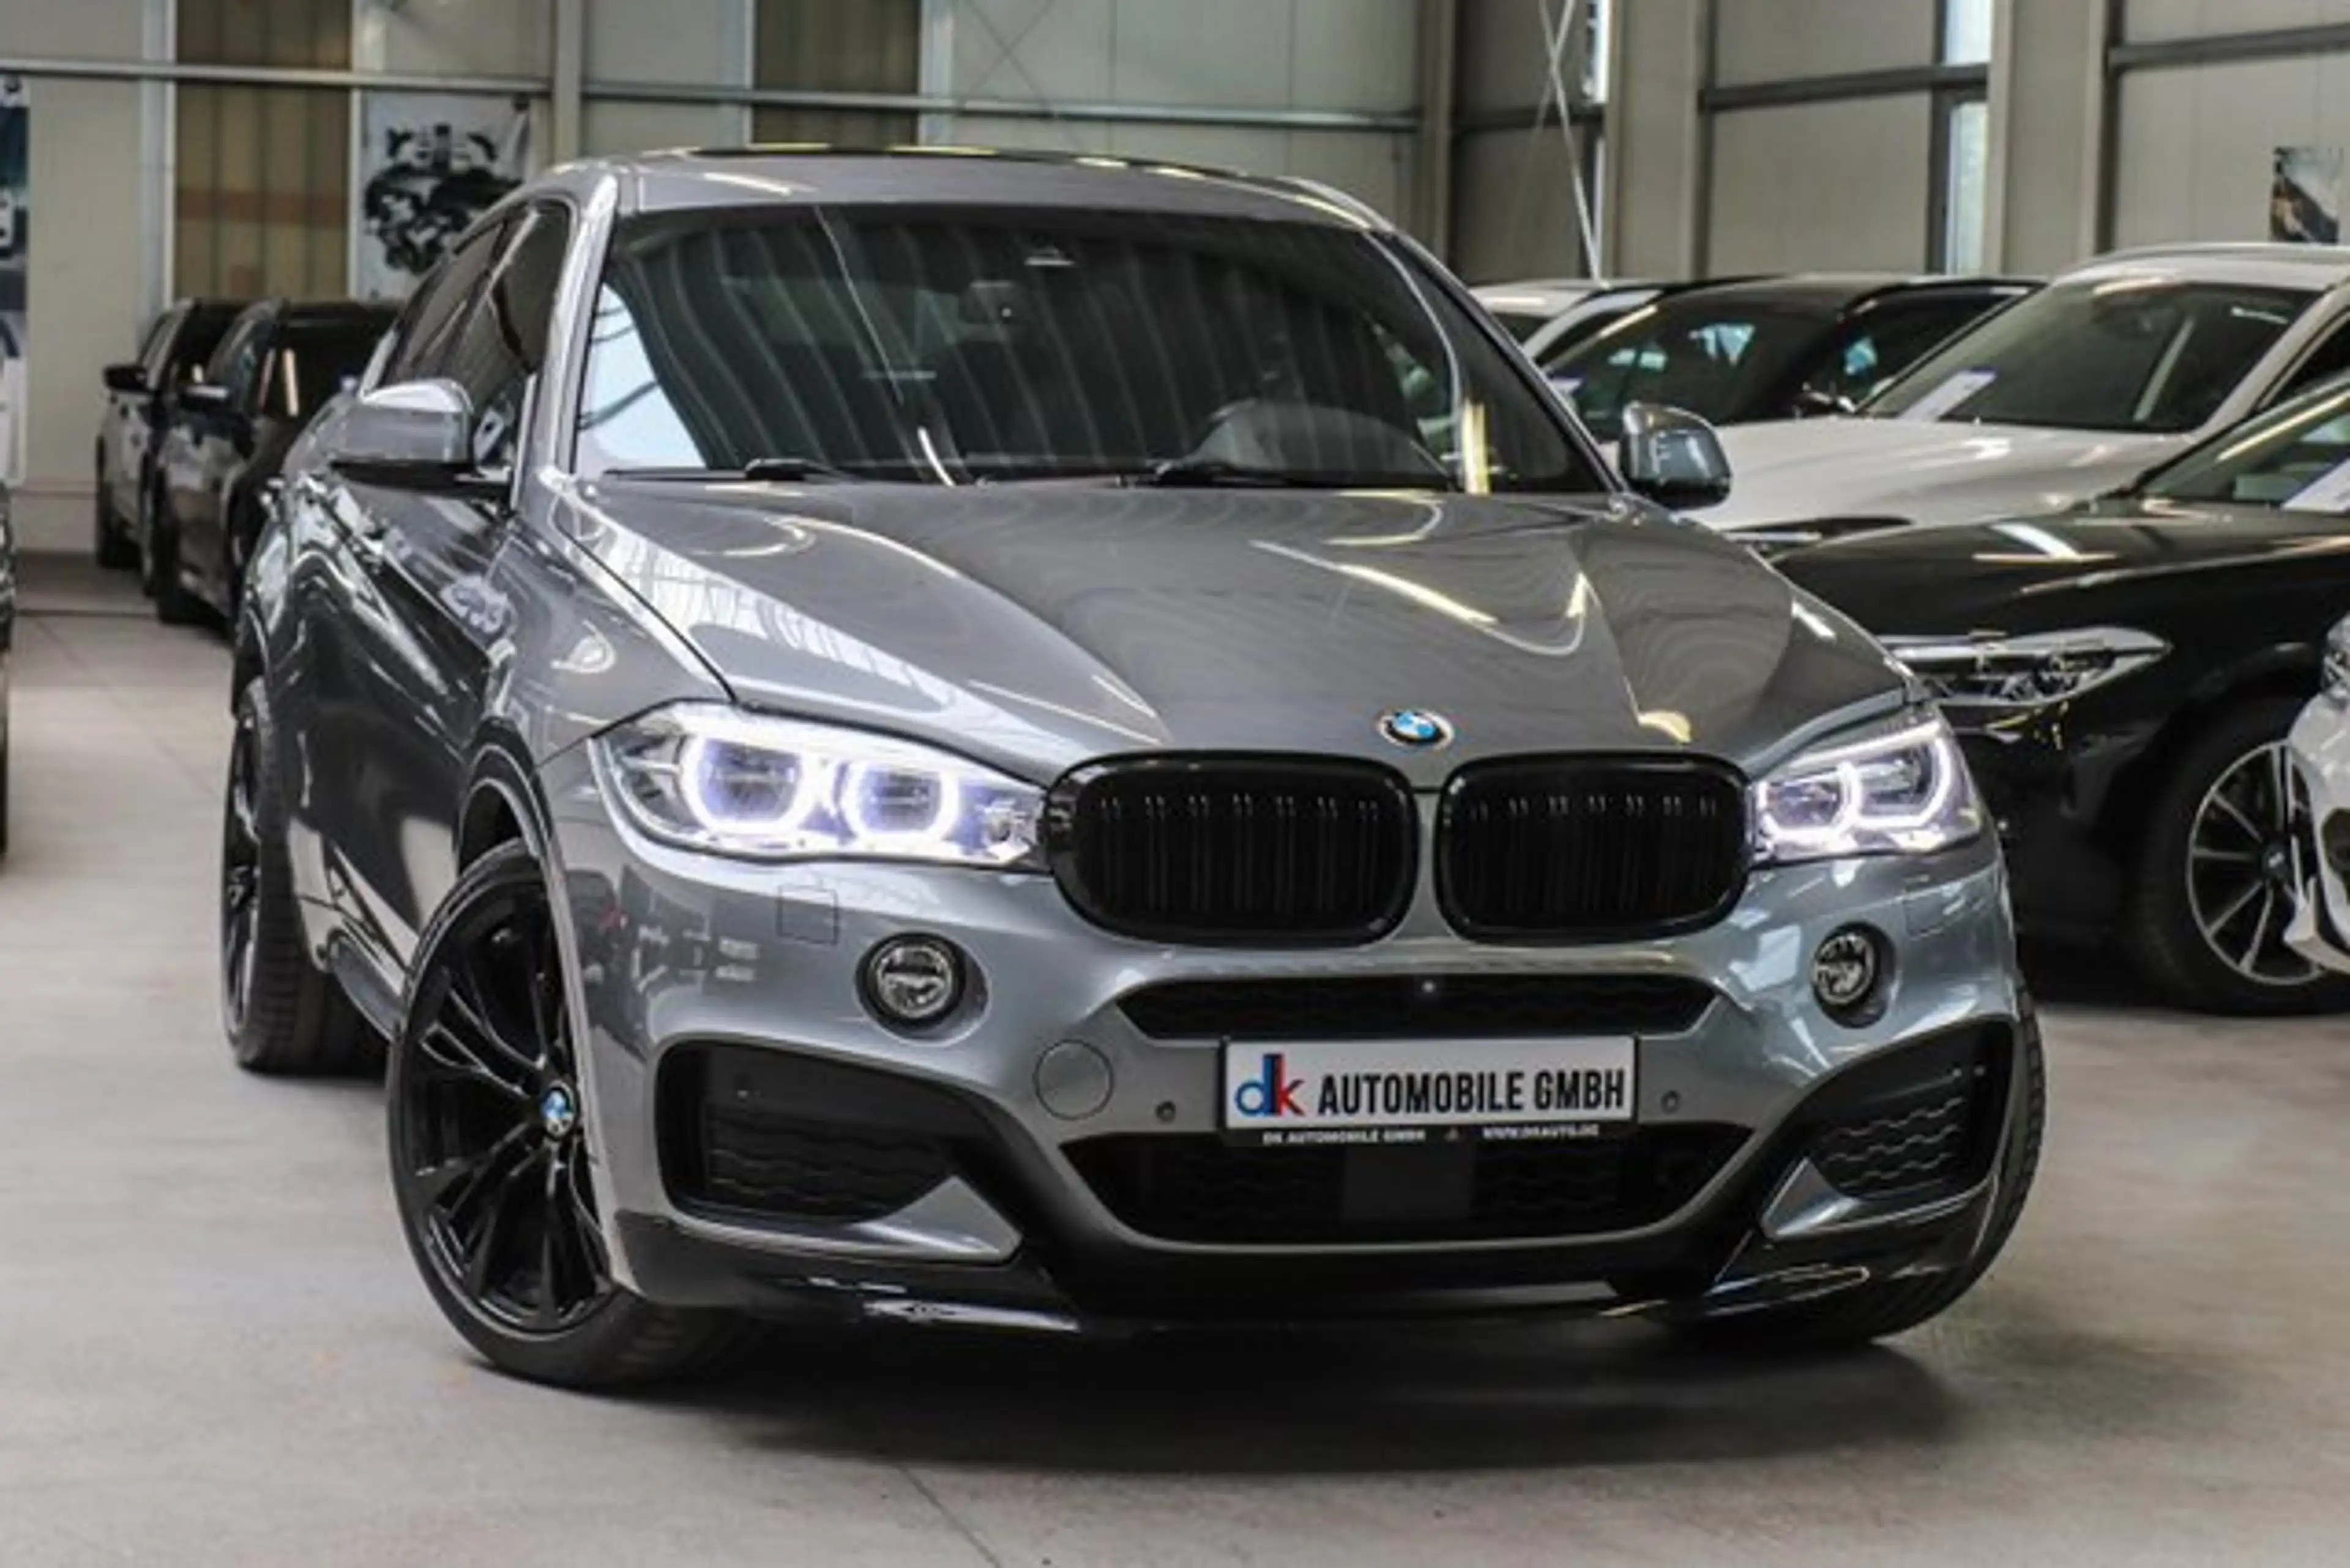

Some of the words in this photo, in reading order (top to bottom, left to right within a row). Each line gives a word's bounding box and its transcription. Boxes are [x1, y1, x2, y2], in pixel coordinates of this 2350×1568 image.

[1234, 1052, 1305, 1117] dk
[1318, 1072, 1524, 1116] AUTOMOBILE
[1534, 1069, 1624, 1111] GMBH
